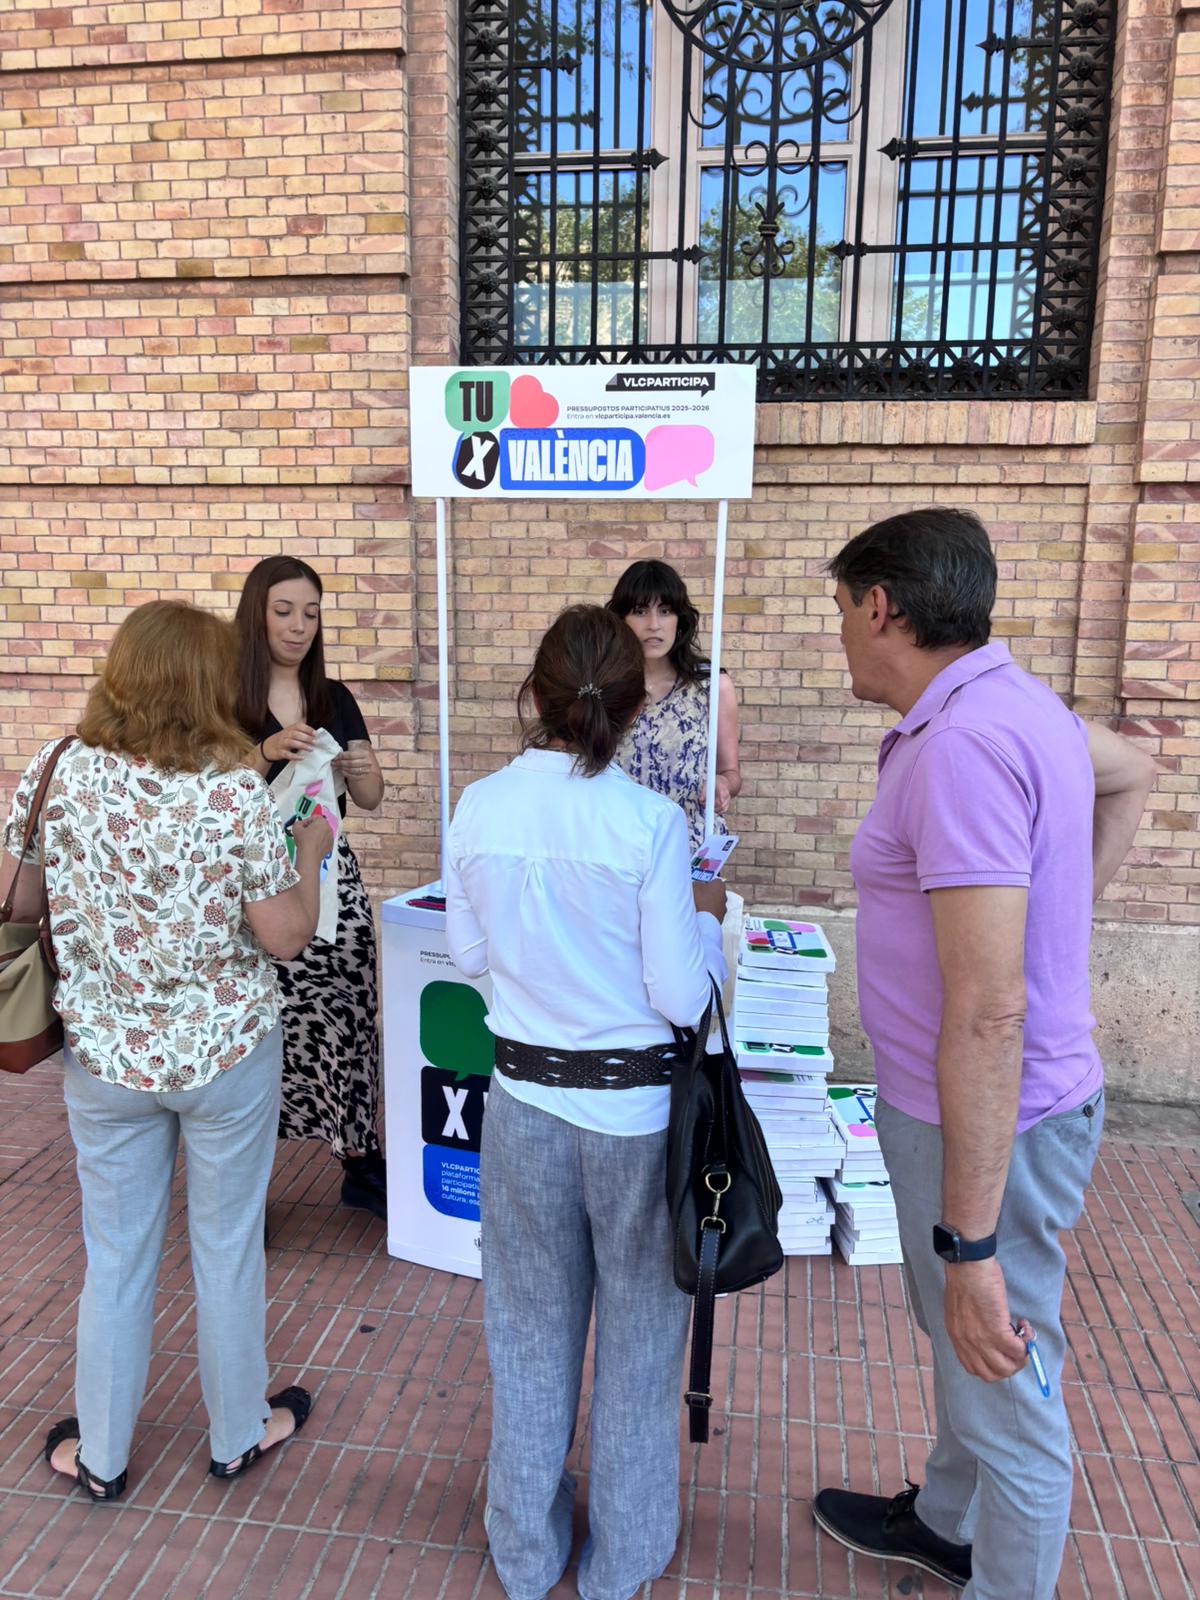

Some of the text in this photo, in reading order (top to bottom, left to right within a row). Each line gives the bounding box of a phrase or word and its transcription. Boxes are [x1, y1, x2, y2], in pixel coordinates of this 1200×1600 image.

[459, 381, 494, 422] TU
[622, 377, 710, 387] VLCPARTICIPA
[594, 412, 671, 420] vlcparticipa.valencia.es
[461, 435, 495, 482] X
[508, 429, 634, 482] VALÈNCIA
[441, 1085, 470, 1140] X
